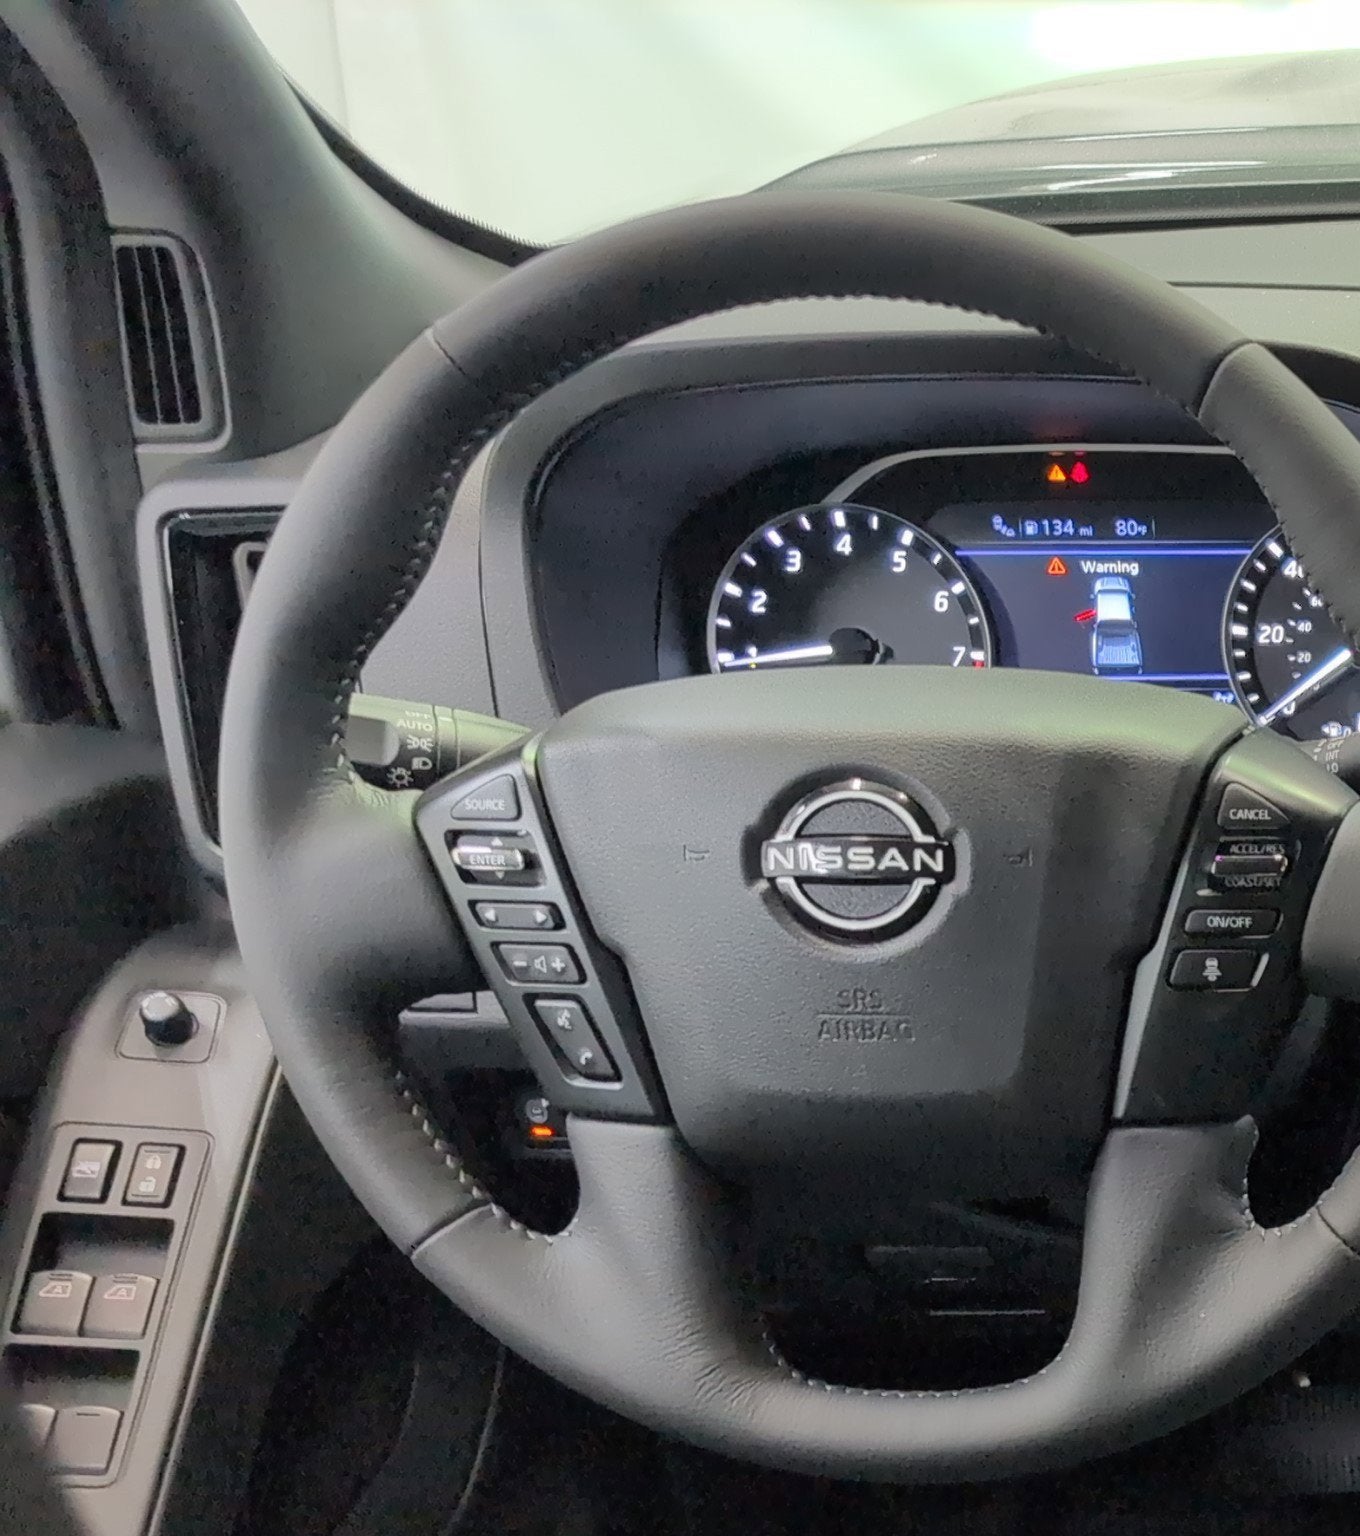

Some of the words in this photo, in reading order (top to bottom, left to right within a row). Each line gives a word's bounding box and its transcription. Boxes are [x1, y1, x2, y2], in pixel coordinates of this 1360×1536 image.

[1042, 519, 1074, 536] 134
[1079, 525, 1093, 536] mi
[836, 533, 852, 555] 4
[785, 550, 801, 572] 3
[892, 550, 907, 572] 5
[1081, 560, 1139, 576] Warning
[750, 590, 767, 613] 2
[934, 591, 949, 612] 6
[1257, 625, 1285, 644] 20
[1297, 621, 1312, 634] 40
[952, 646, 967, 668] 7
[1297, 652, 1312, 664] 20
[397, 720, 433, 732] AUTO
[464, 798, 505, 811] SOURCE
[1229, 808, 1271, 820] CANCEL
[469, 854, 506, 866] ENTER
[766, 843, 945, 873] NISSAN
[1207, 916, 1253, 929] ON/OFF
[836, 987, 885, 1012] SRS
[817, 1019, 917, 1043] AIRBAG
